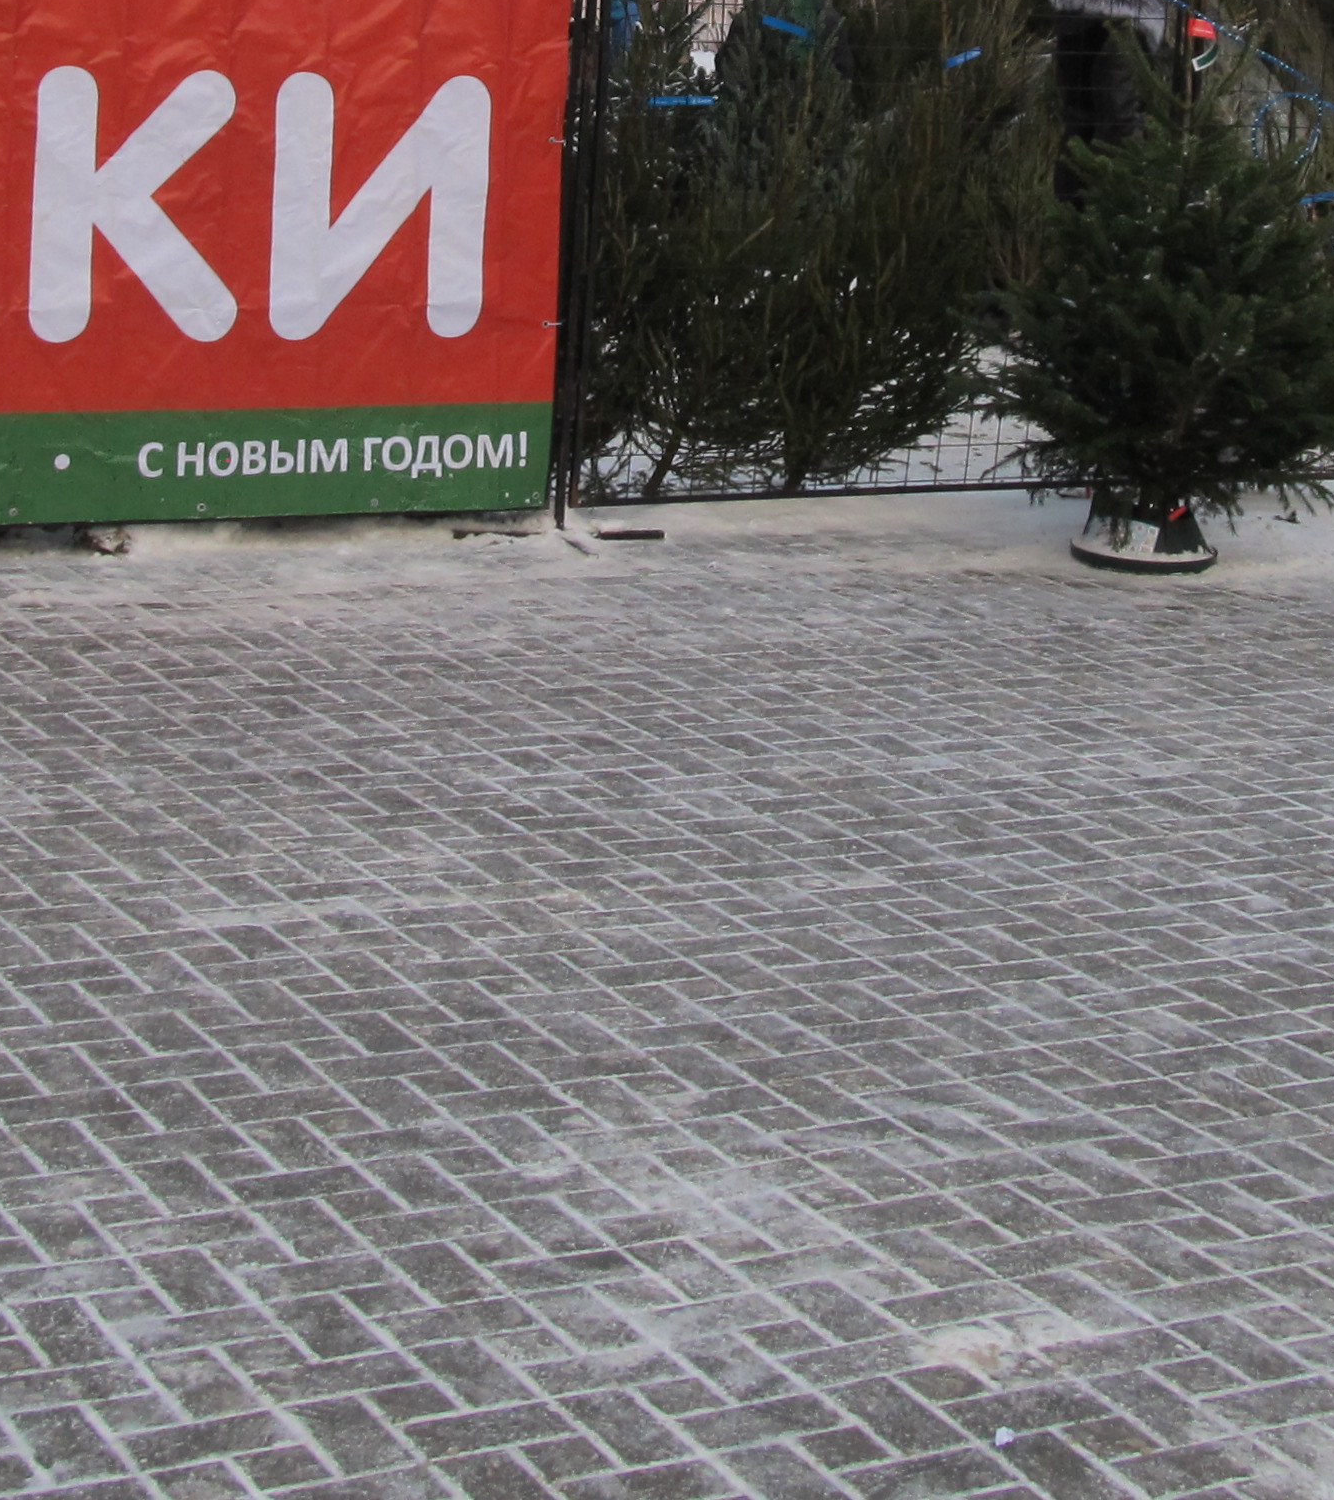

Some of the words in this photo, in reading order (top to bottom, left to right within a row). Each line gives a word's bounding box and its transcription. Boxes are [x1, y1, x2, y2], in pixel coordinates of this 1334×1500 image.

[137, 442, 164, 477] С
[177, 438, 348, 477] НОВЫМ
[363, 431, 528, 479] ГОДОМ!
